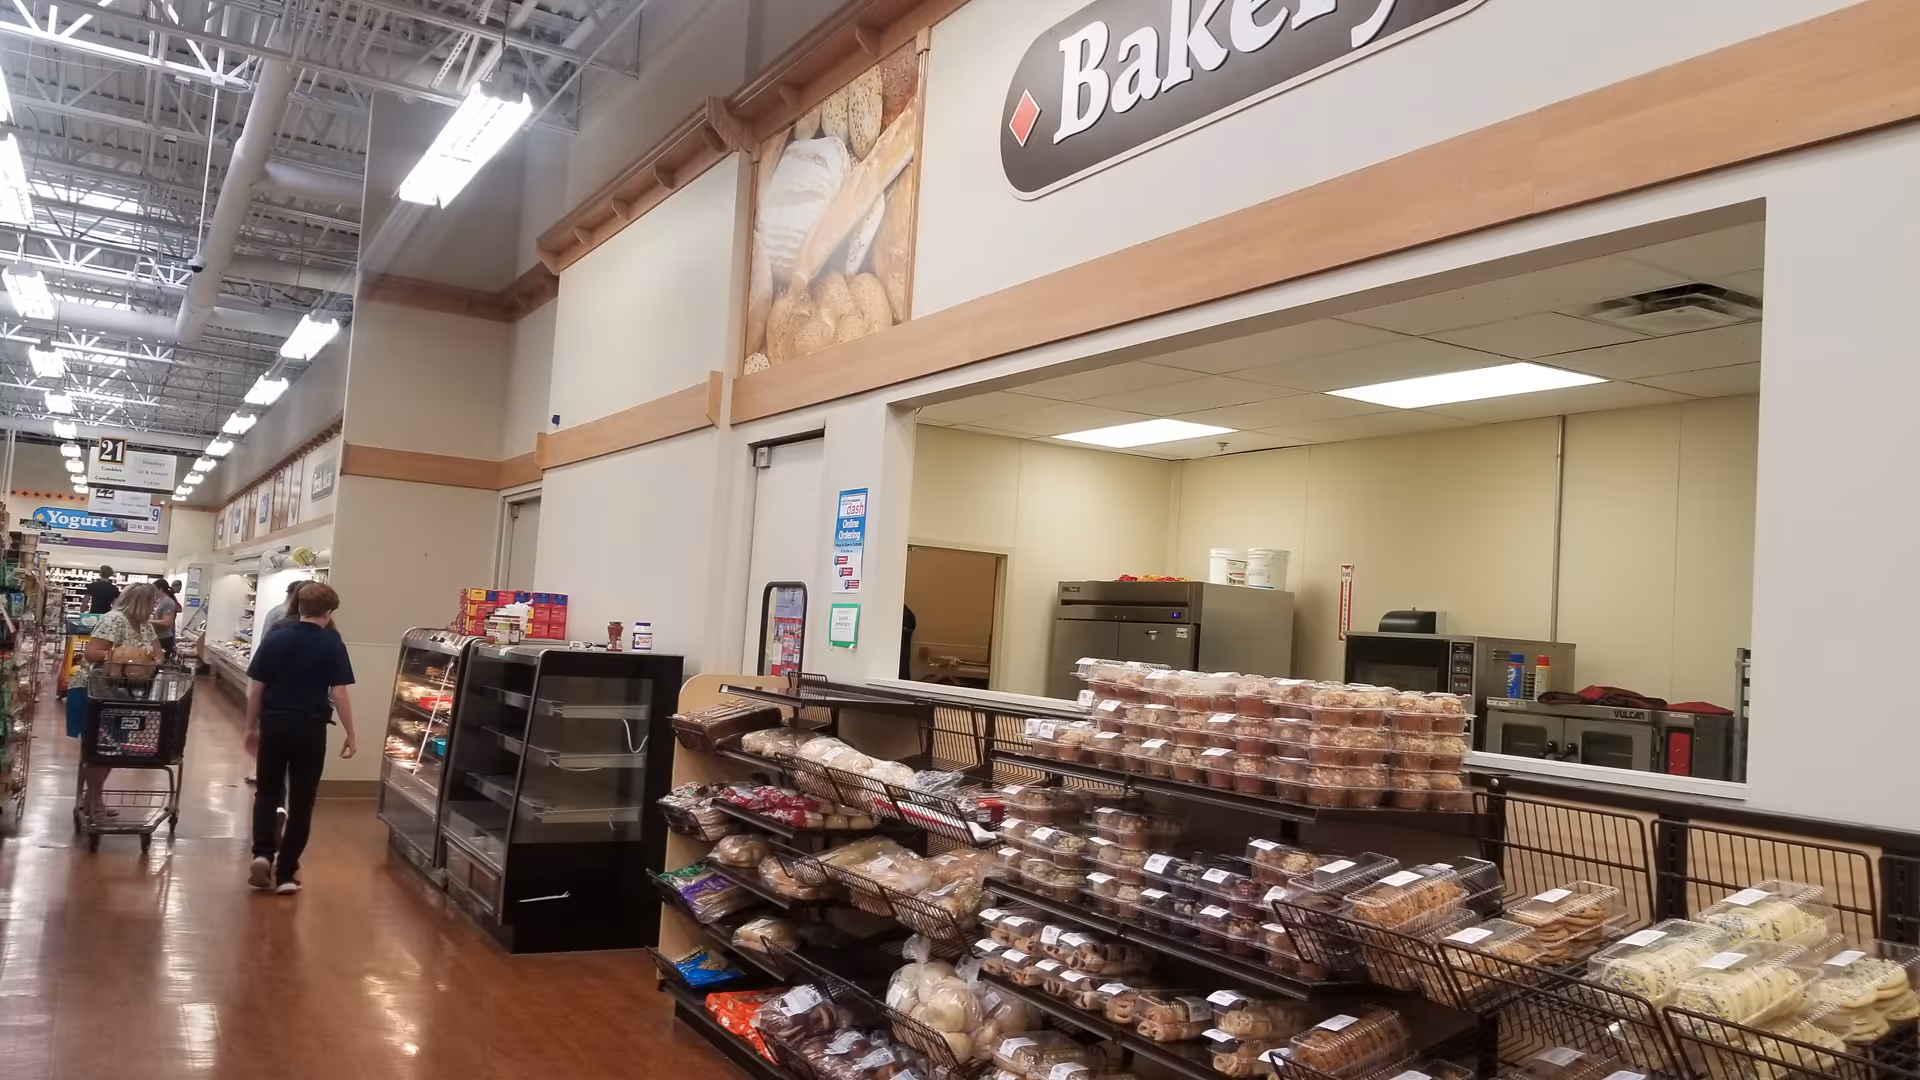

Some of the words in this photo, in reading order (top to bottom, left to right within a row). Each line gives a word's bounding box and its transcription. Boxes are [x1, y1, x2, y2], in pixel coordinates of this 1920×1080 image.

[1053, 0, 1395, 145] Bake
[100, 440, 124, 461] 21
[47, 510, 107, 529] Yogurt
[1613, 709, 1645, 720] VULCAN
